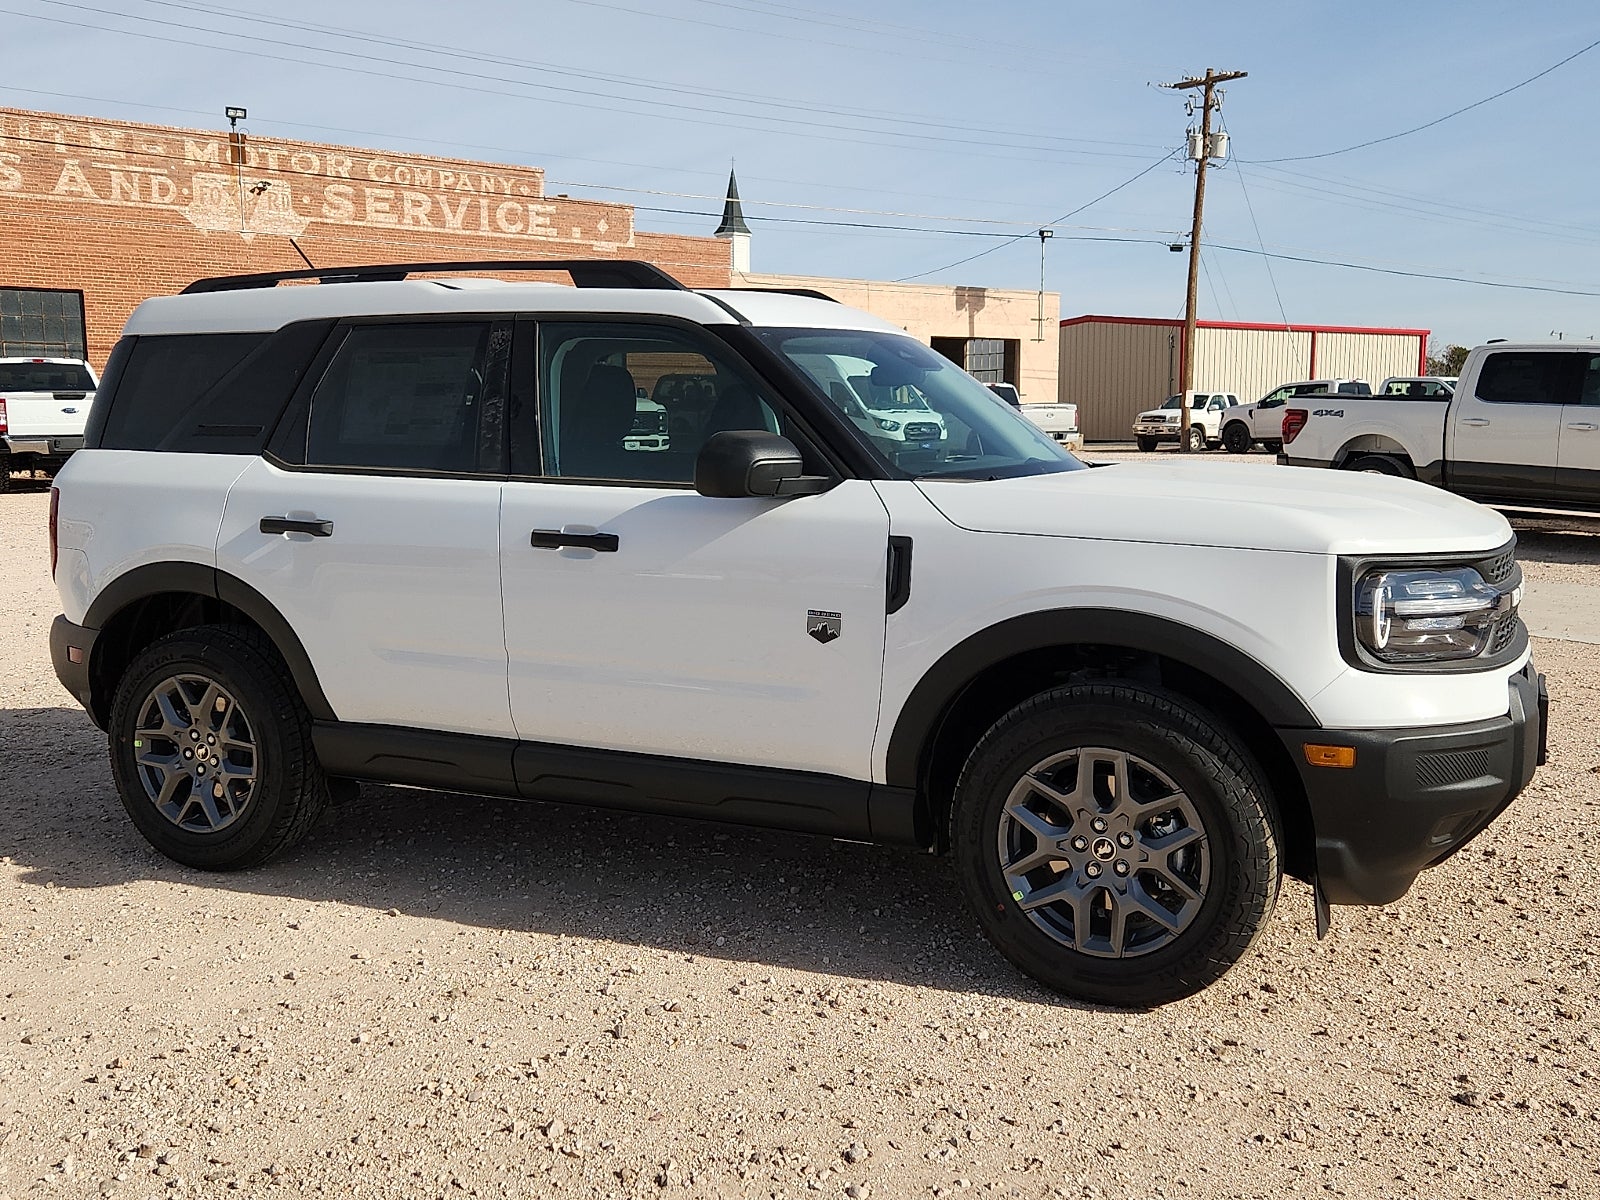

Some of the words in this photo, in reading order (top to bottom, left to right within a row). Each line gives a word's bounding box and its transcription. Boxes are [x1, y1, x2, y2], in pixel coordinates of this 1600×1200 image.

[53, 160, 177, 204] AND
[322, 184, 557, 237] SERVICE
[183, 139, 353, 178] MOTOR
[367, 157, 519, 195] COMPANY
